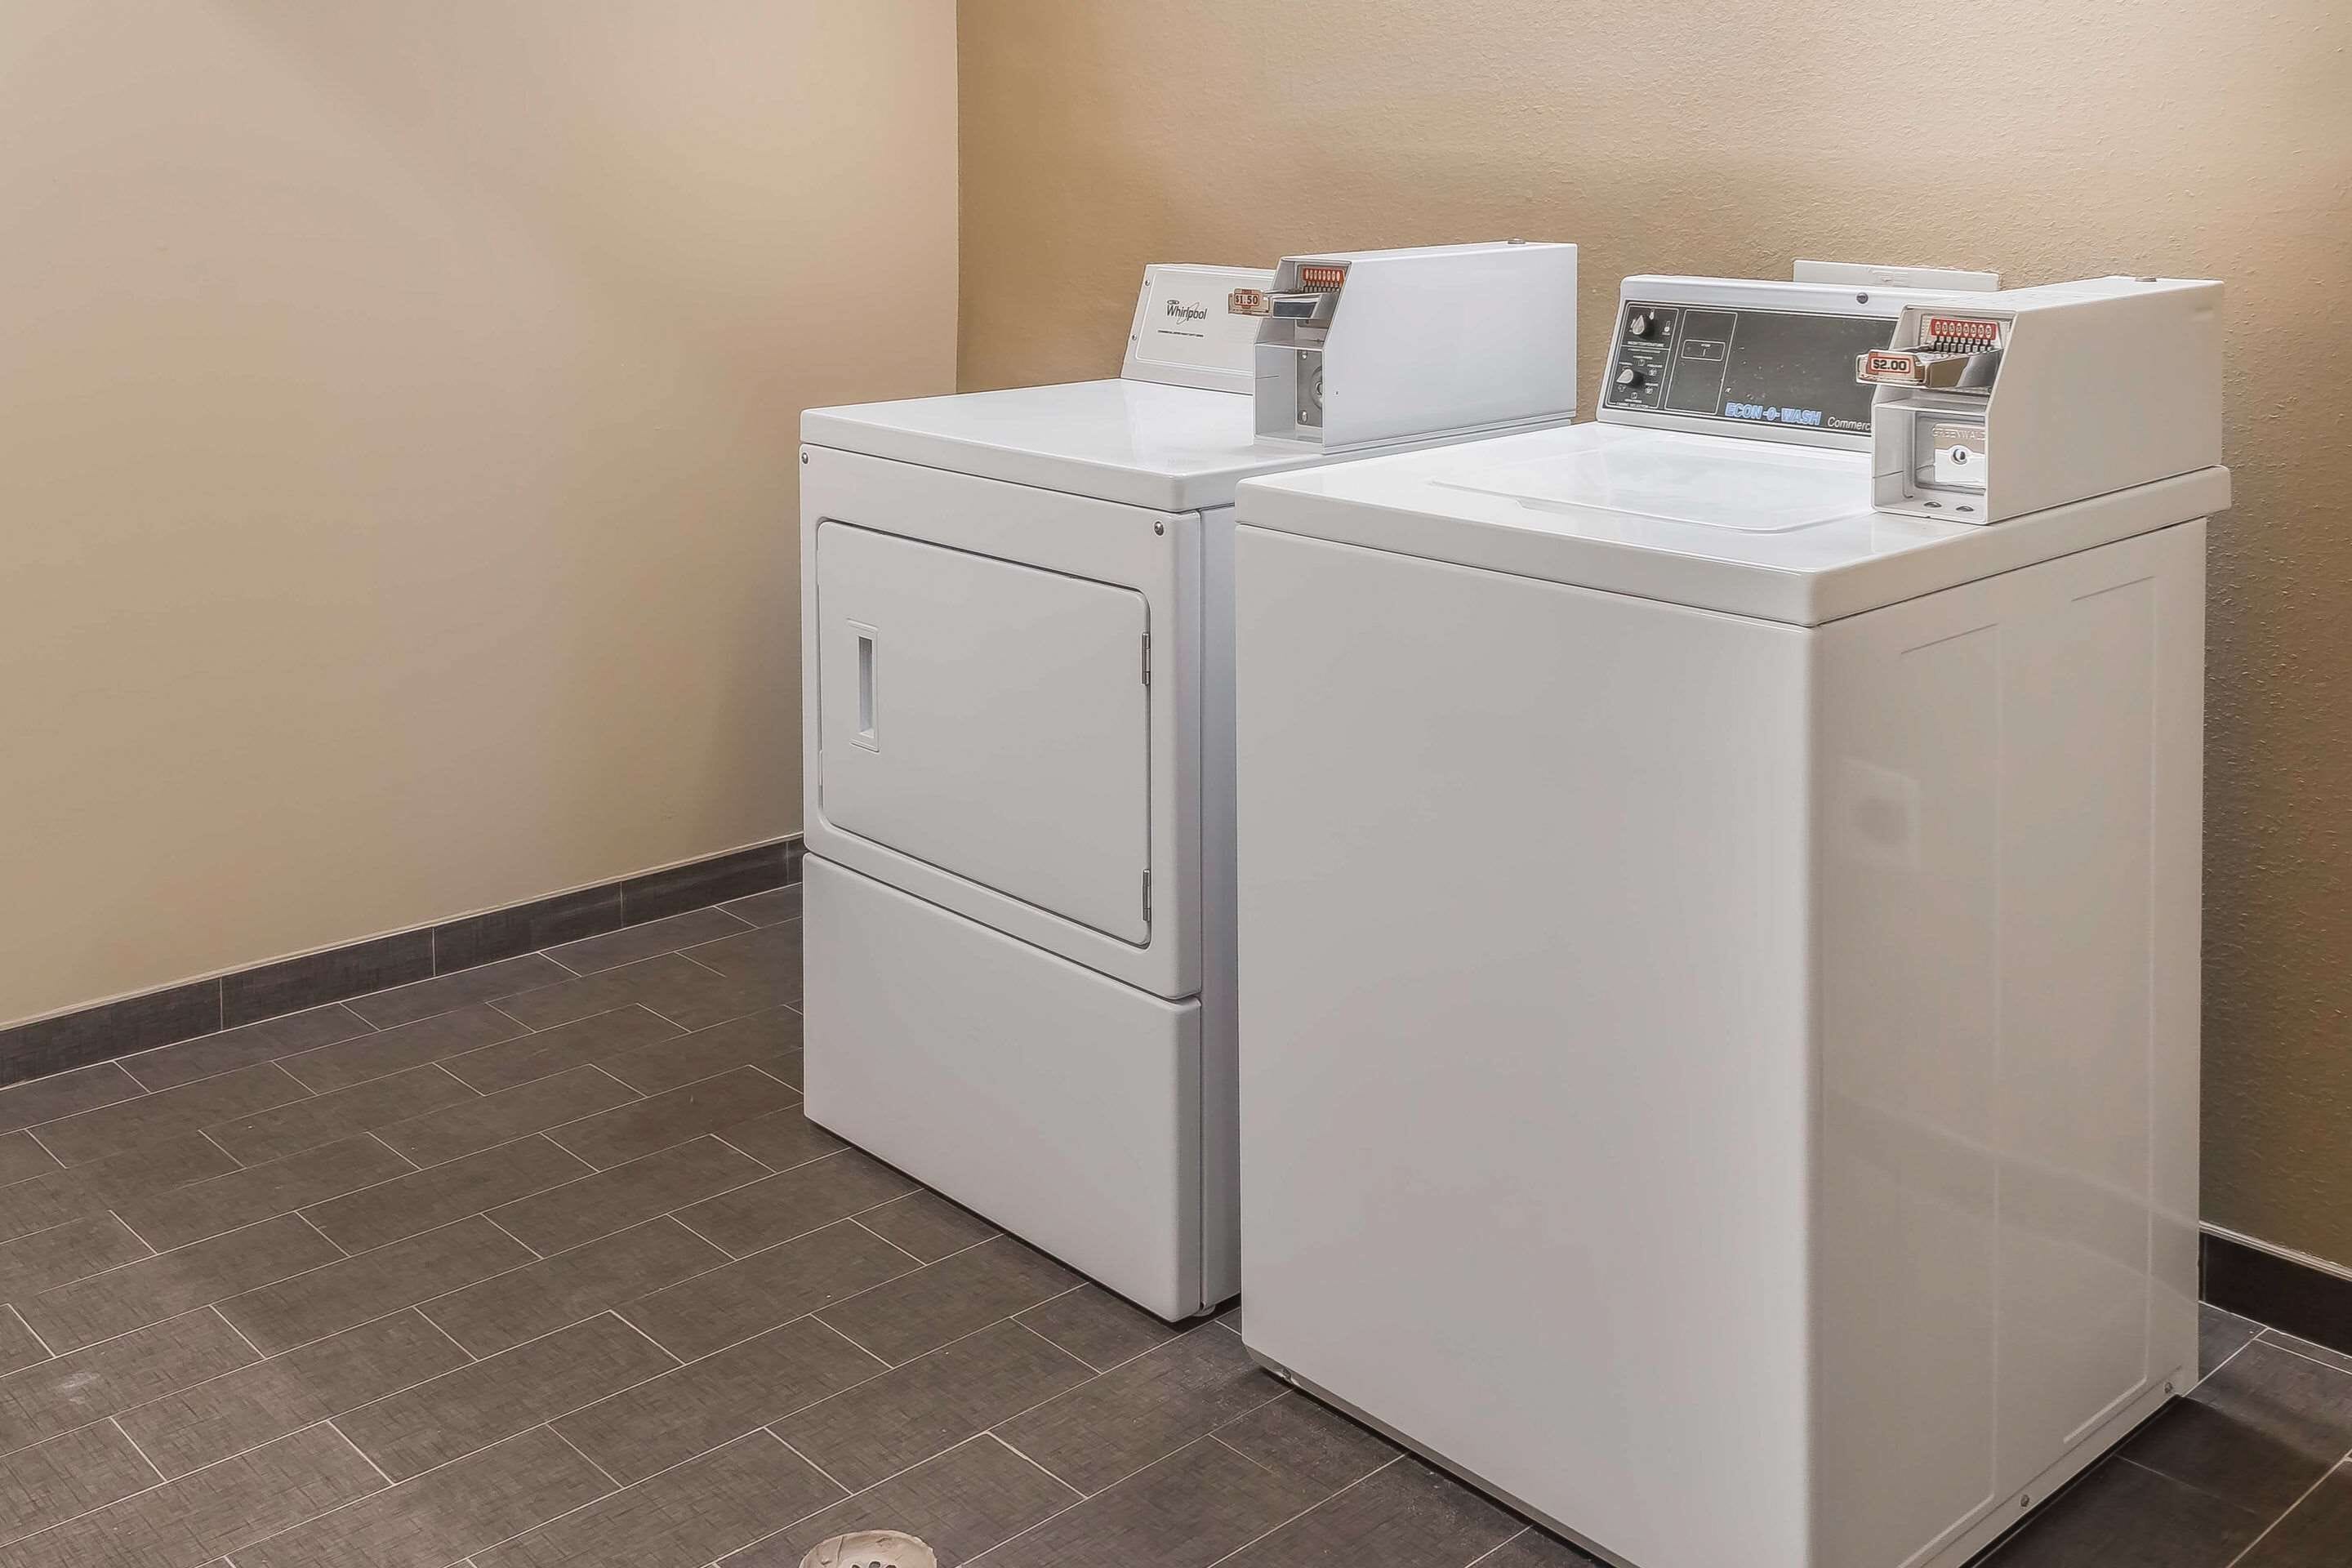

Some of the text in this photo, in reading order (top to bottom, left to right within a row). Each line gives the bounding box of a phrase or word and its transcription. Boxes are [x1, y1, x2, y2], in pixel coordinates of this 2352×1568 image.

[1235, 295, 1258, 305] $1.50
[1166, 305, 1208, 321] Whirlpool
[1873, 359, 1907, 371] $2.00
